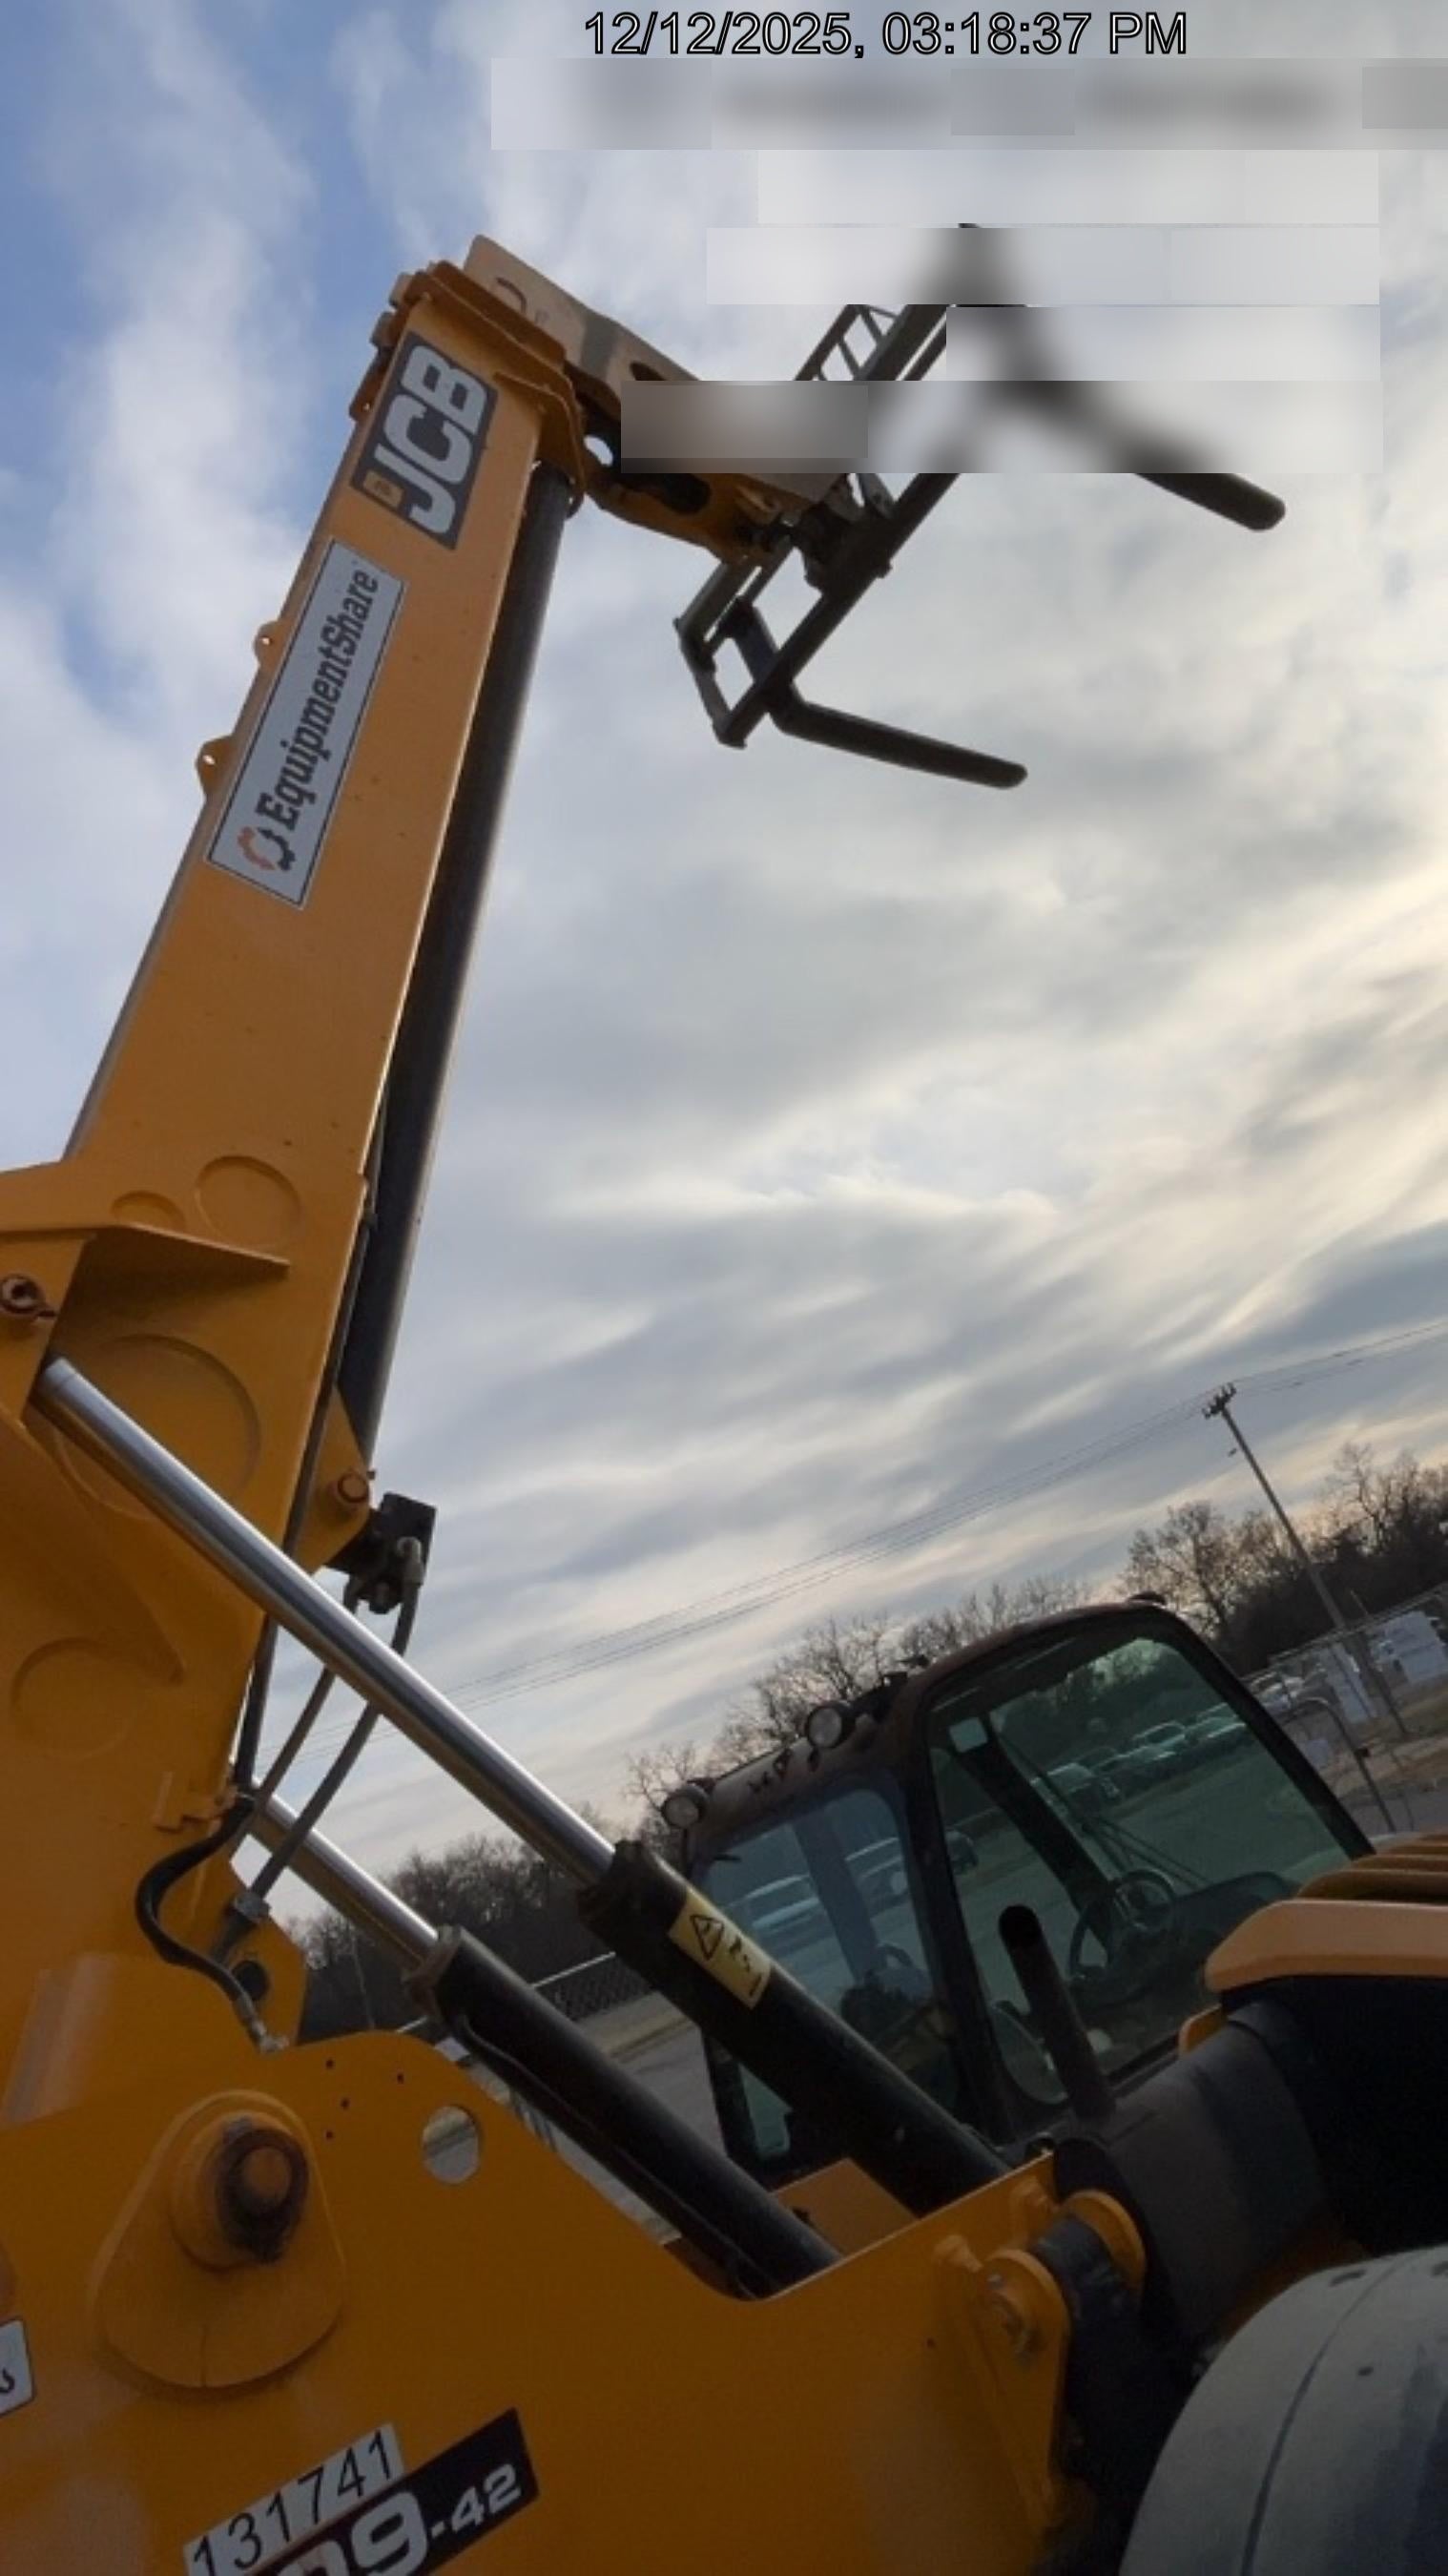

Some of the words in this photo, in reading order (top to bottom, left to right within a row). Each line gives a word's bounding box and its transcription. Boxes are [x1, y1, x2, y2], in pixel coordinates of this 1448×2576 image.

[374, 344, 488, 534] JCB
[255, 570, 379, 832] EquipmentShare
[194, 2429, 391, 2576] 131741
